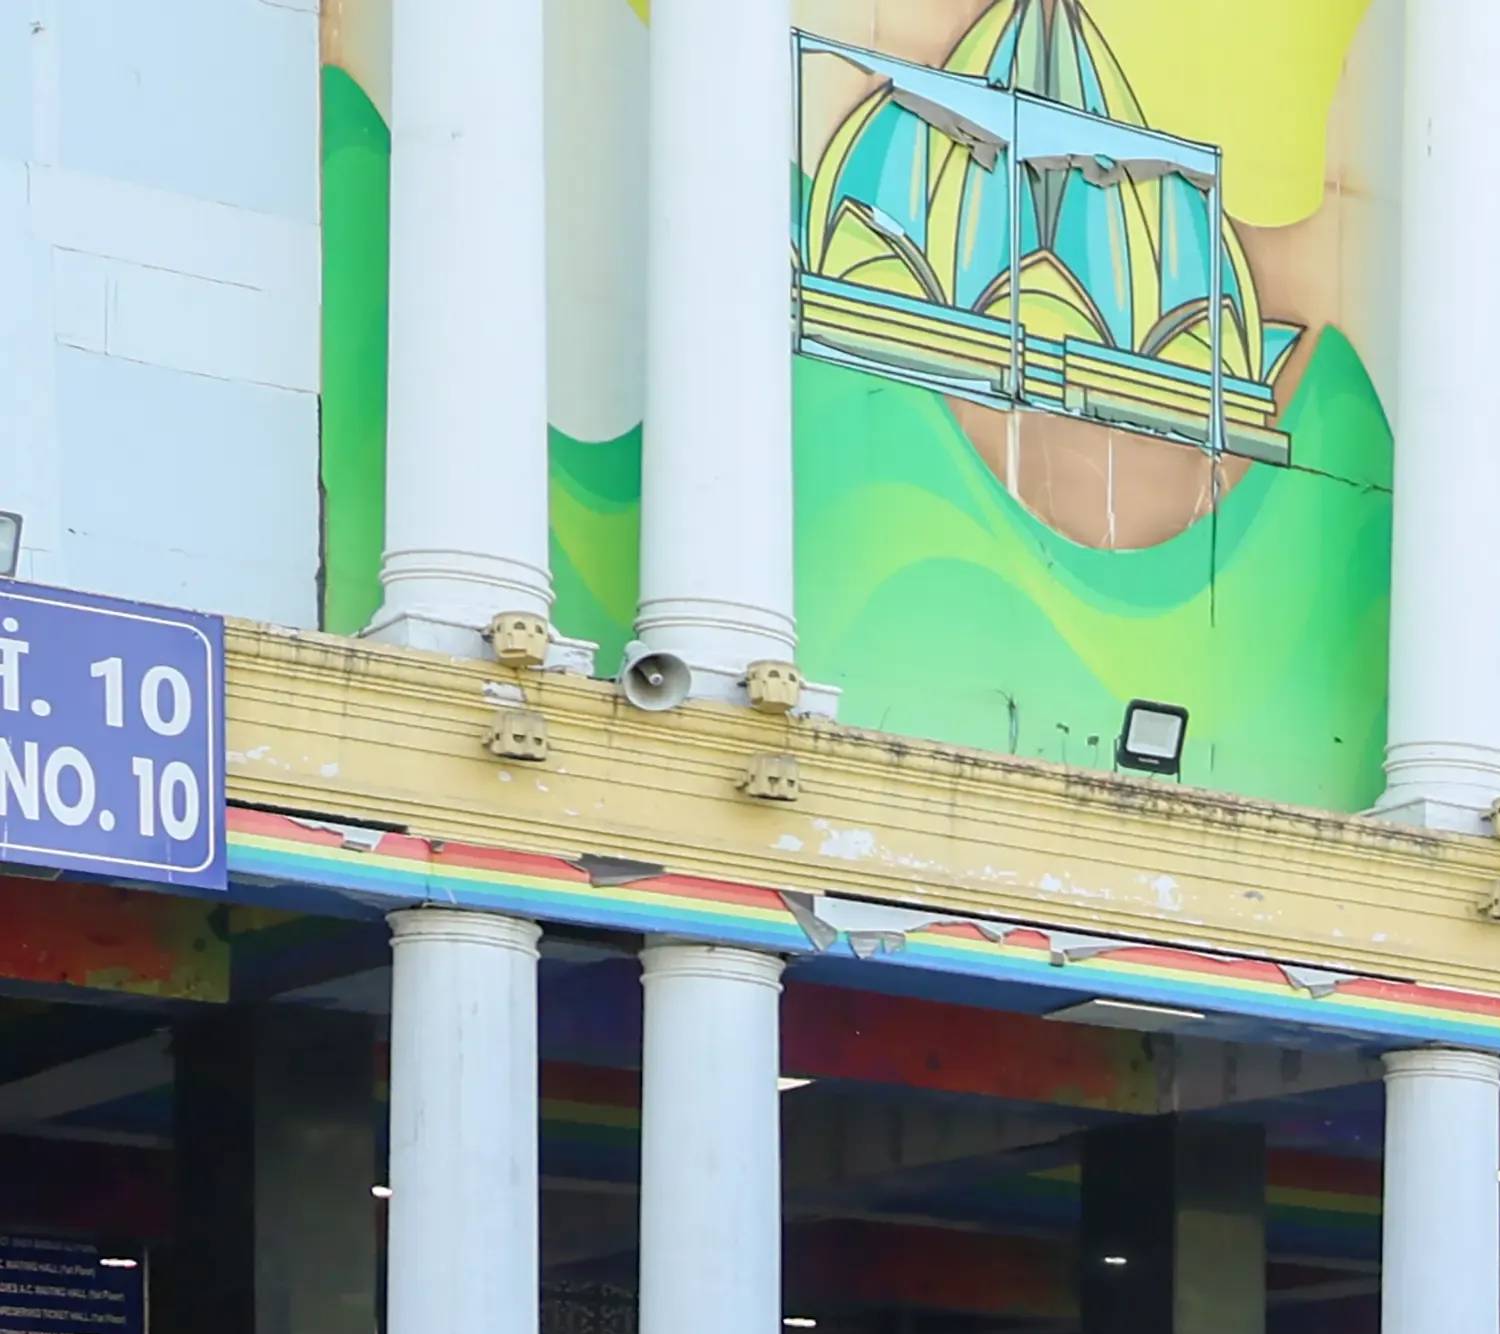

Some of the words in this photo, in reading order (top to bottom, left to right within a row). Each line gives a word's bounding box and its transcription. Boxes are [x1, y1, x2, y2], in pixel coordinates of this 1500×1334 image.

[90, 656, 192, 737] 10
[0, 736, 116, 832] NO.
[132, 756, 199, 842] 10
